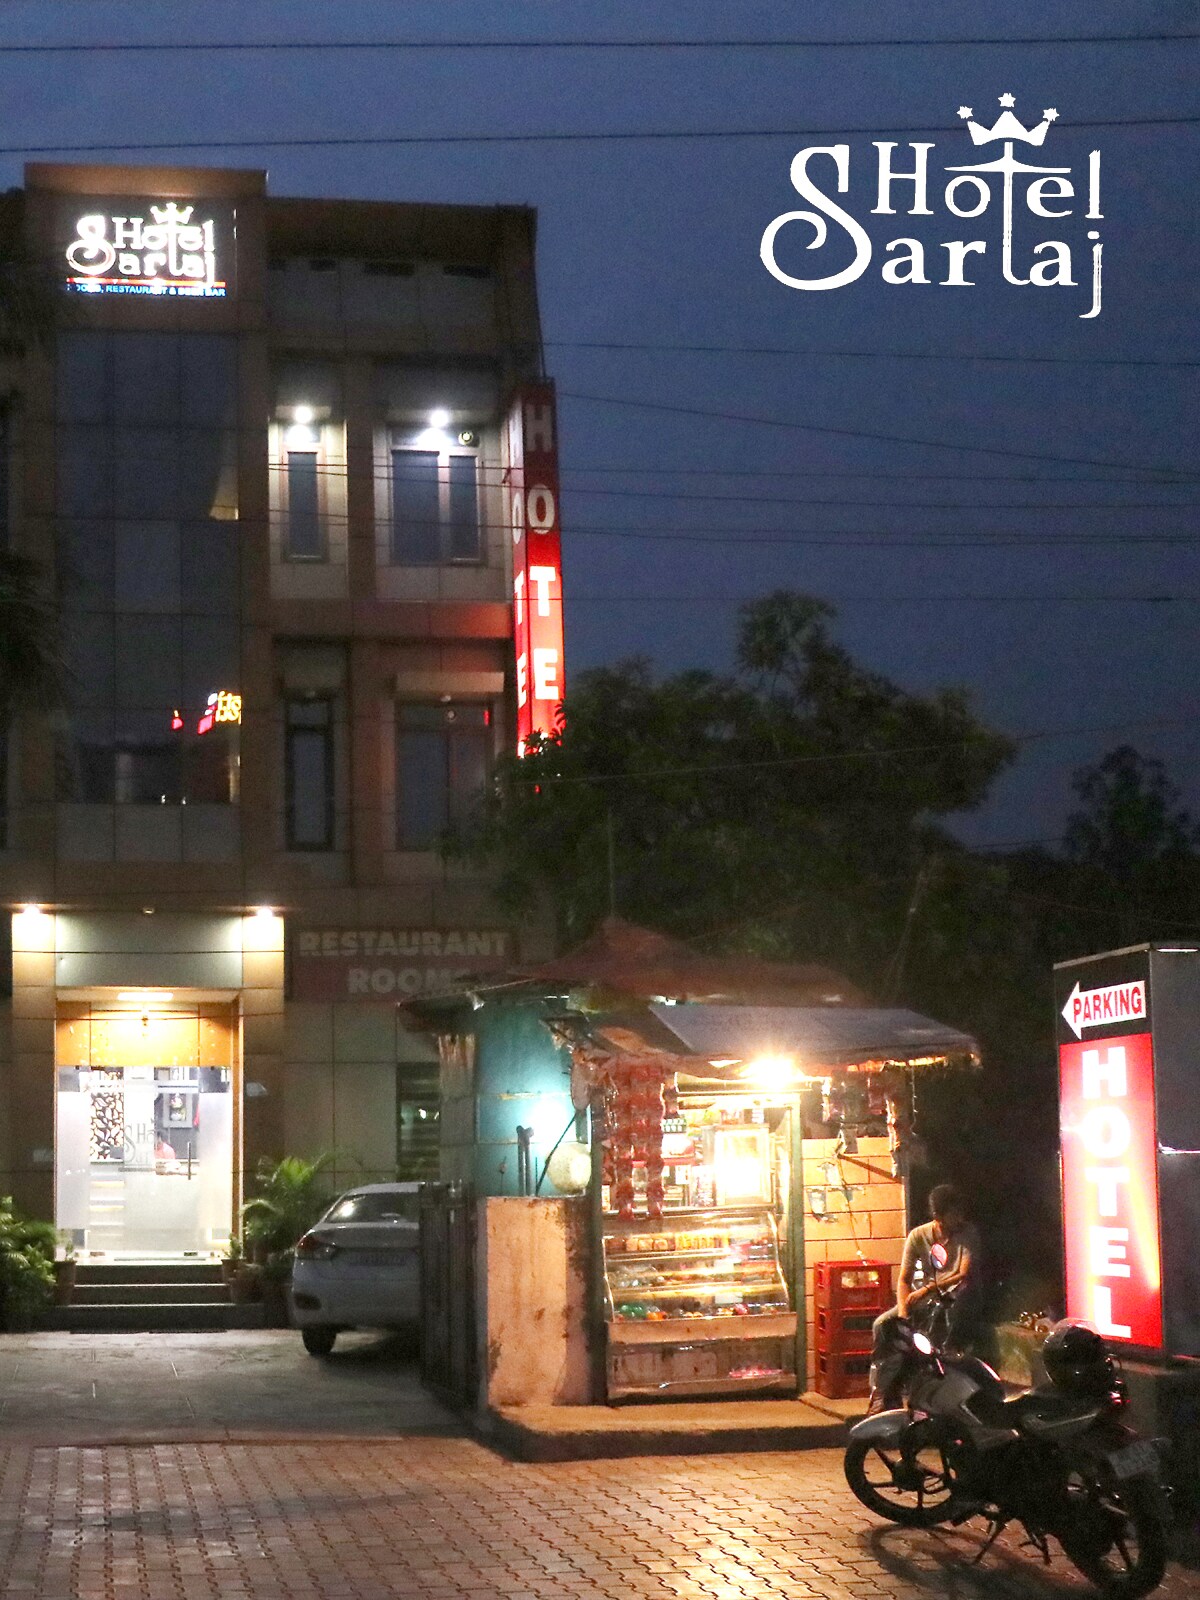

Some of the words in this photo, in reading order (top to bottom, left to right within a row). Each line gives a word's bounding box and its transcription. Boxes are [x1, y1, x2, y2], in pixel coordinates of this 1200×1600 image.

[66, 214, 216, 287] Sartaj
[111, 216, 216, 252] Hotel
[525, 403, 560, 757] HOTE
[300, 931, 509, 957] RESTAURANT
[1073, 986, 1142, 1023] PARKING
[1081, 1045, 1132, 1340] HOTEL
